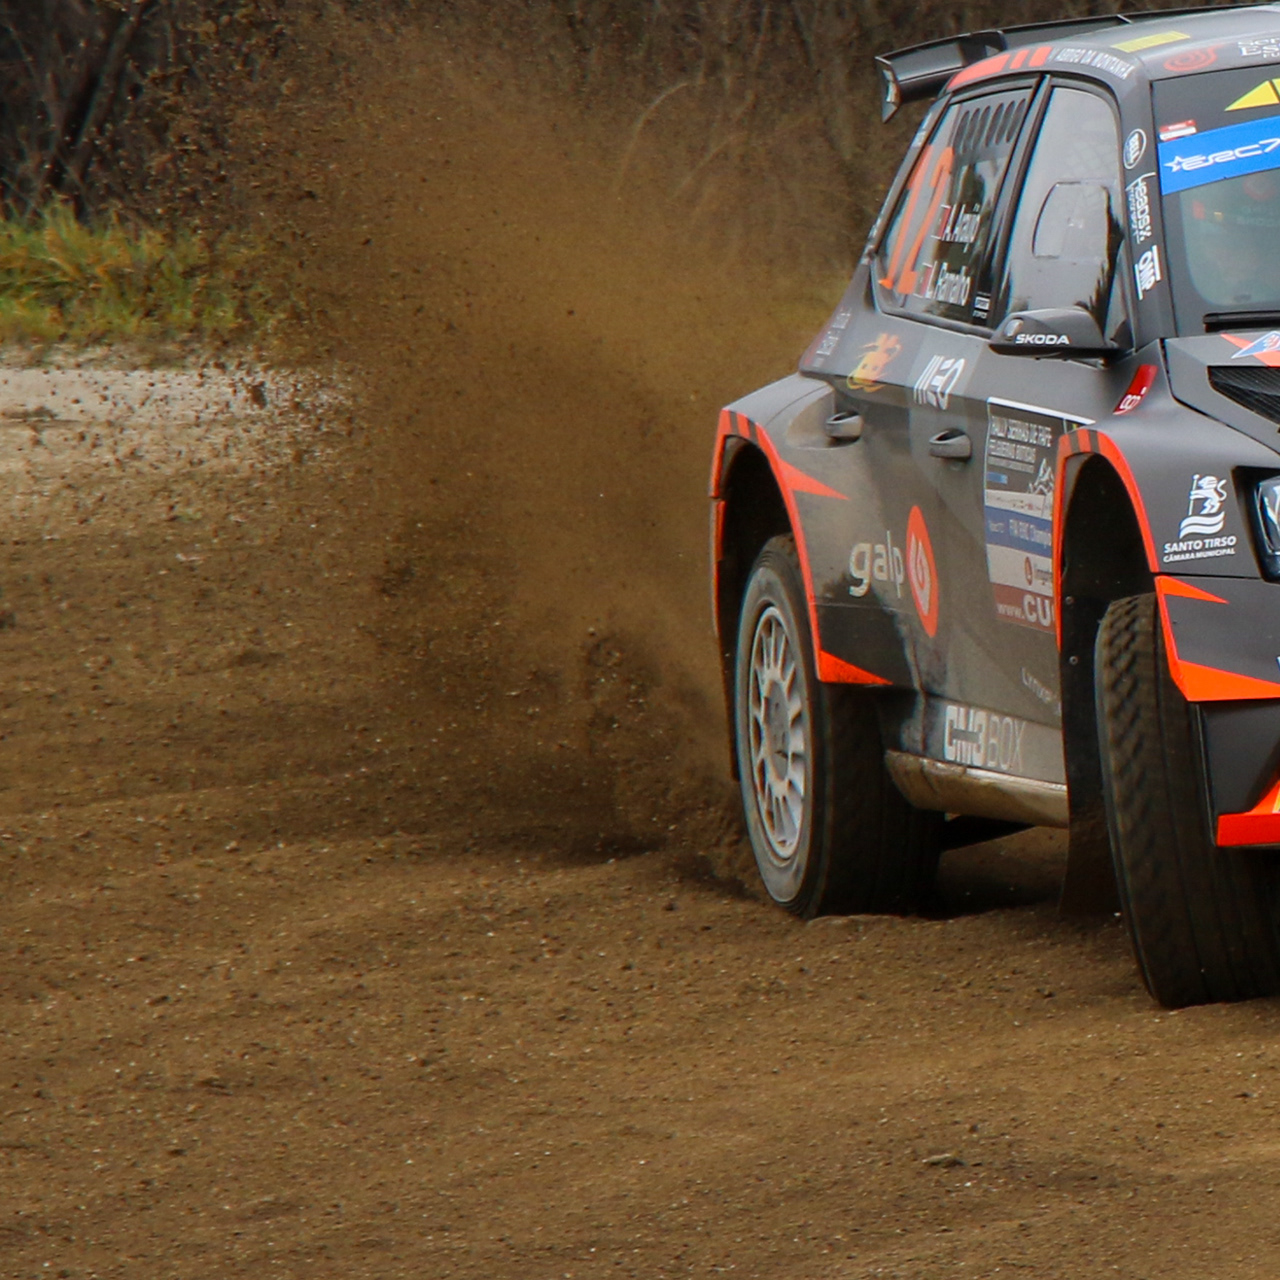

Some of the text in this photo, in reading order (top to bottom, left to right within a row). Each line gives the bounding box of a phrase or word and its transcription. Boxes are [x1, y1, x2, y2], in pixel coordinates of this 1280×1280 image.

[878, 143, 955, 295] 12
[1138, 250, 1156, 291] OMP
[1014, 333, 1070, 346] SKODA
[1163, 535, 1237, 554] SANTO TIRSO
[1163, 547, 1236, 563] CÂMARA MUNICIPAL
[849, 529, 905, 599] galp
[996, 593, 1055, 627] www.CU
